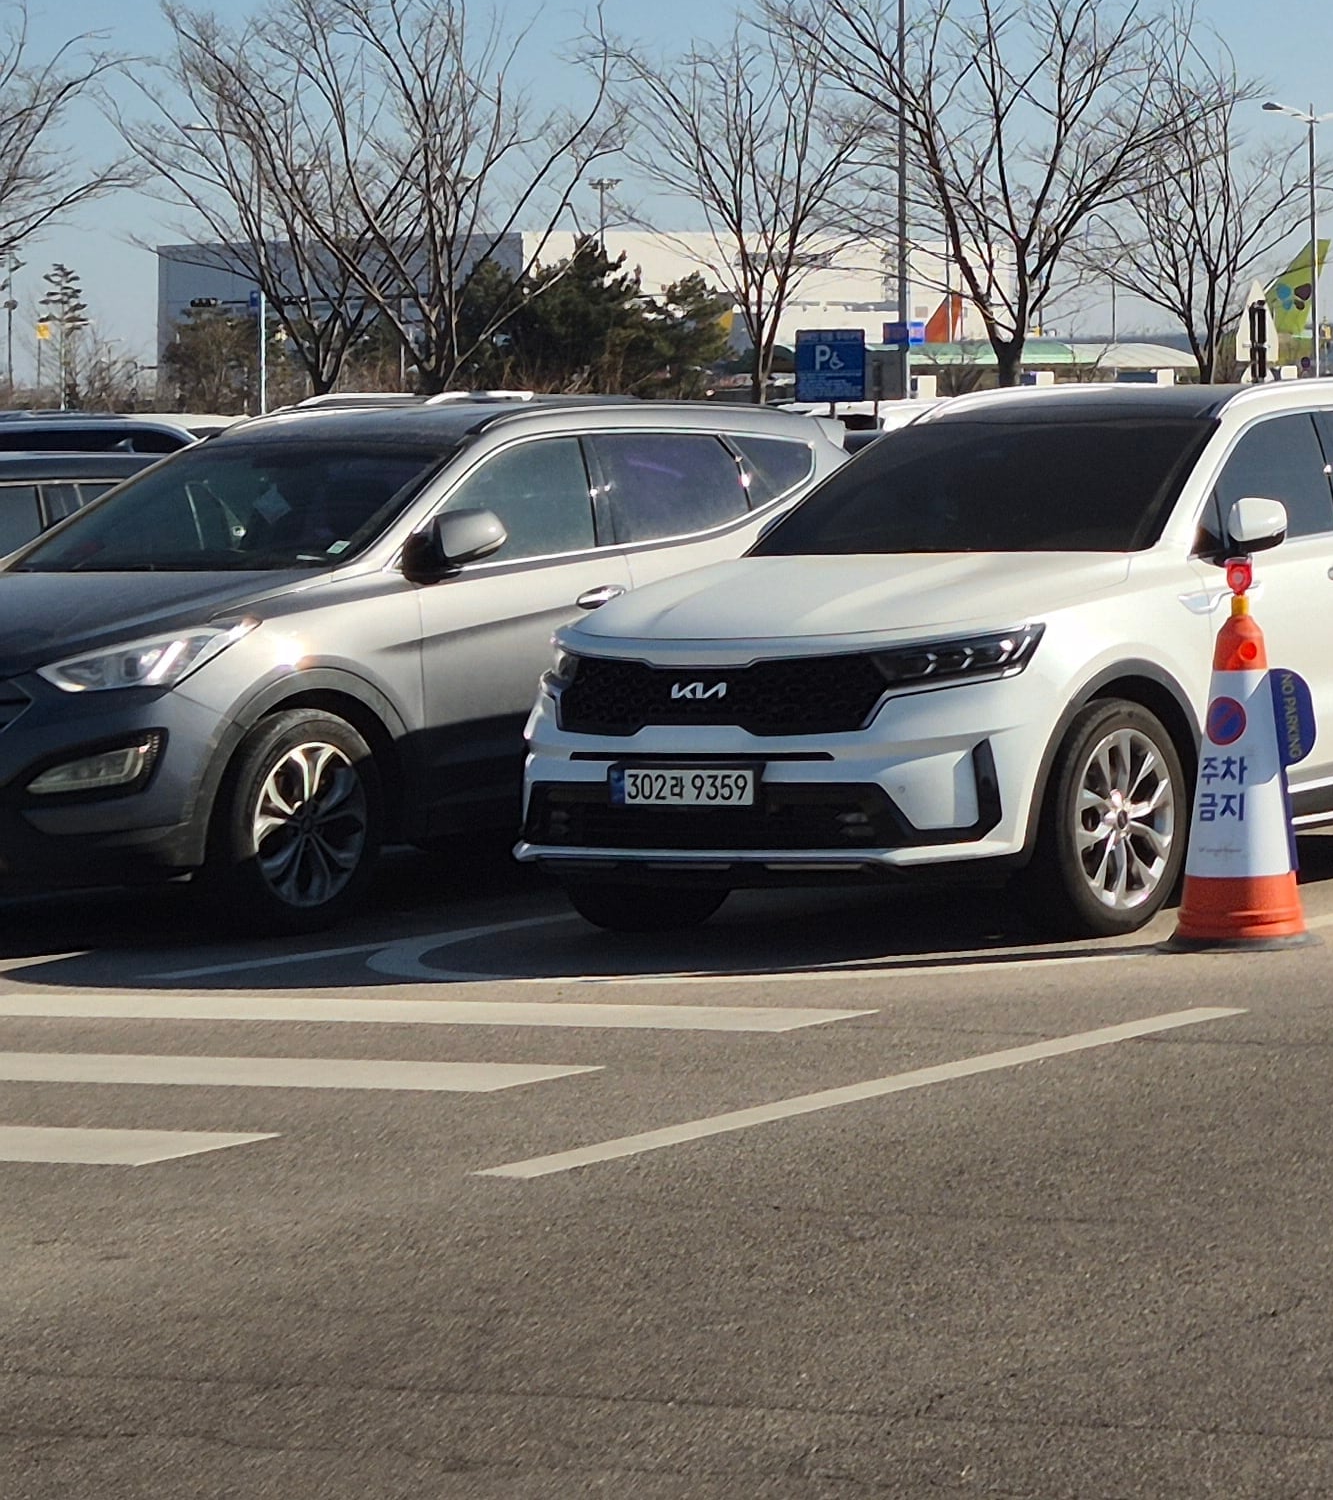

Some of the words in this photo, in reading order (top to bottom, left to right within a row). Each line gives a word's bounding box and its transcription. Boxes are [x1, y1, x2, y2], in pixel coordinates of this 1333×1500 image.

[814, 344, 832, 370] P
[670, 682, 728, 699] KIA
[1280, 672, 1297, 695] NO
[1283, 698, 1304, 760] PARKING
[1201, 756, 1248, 786] 주차
[626, 773, 685, 800] 302라
[691, 774, 749, 801] 9359
[1198, 792, 1245, 822] 금지
